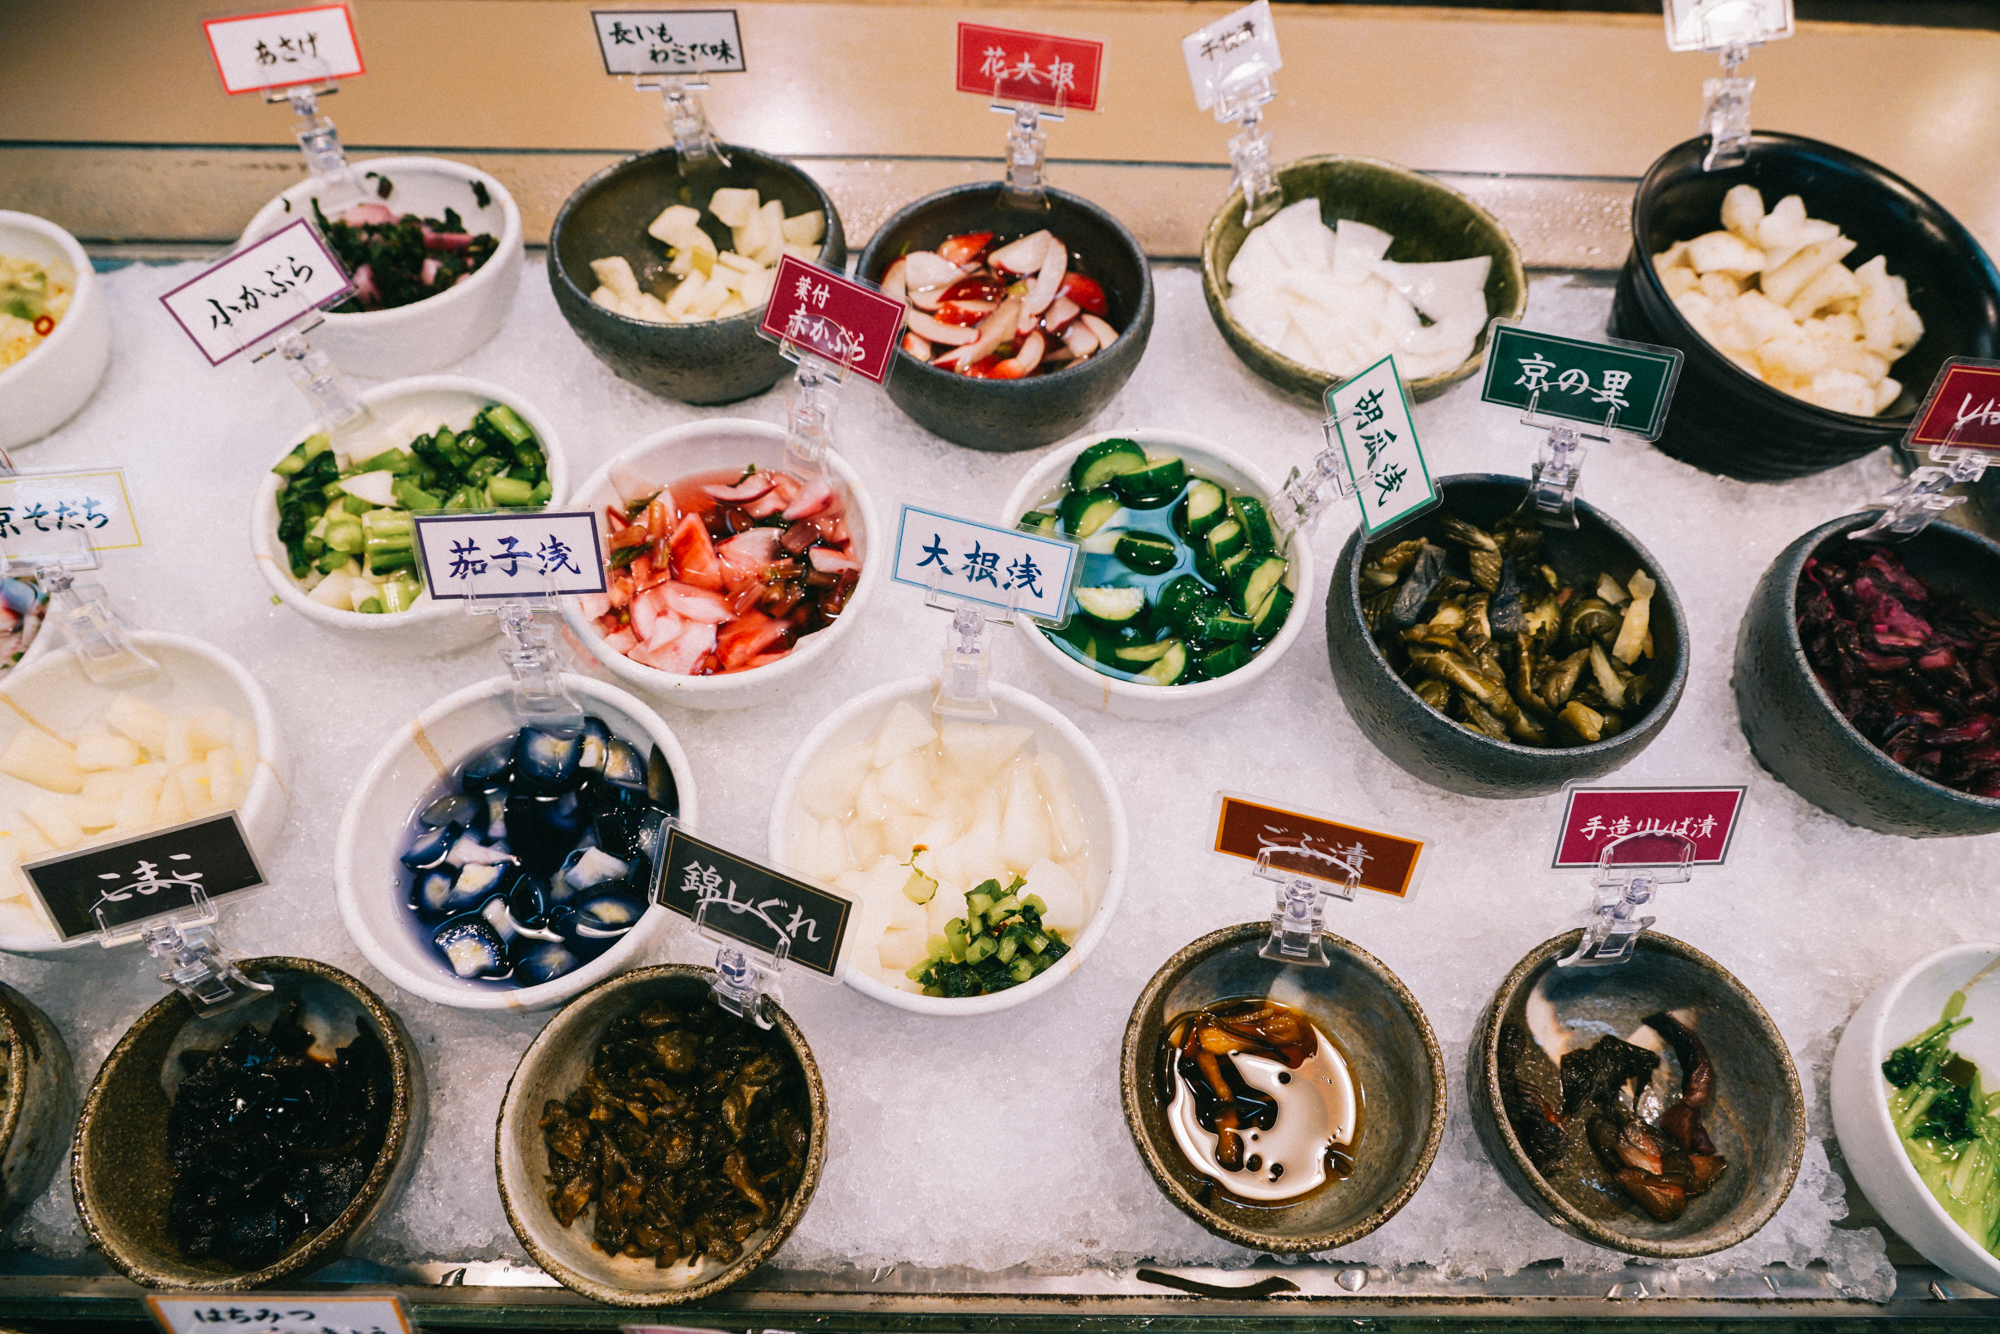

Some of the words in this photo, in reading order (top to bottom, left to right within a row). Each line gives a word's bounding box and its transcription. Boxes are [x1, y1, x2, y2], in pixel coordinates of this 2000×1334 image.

[255, 32, 318, 65] あさげ
[609, 21, 673, 45] 長いも
[981, 46, 1076, 90] 花大根
[205, 256, 311, 330] 小かぶら
[794, 275, 830, 309] 葉付
[785, 303, 866, 362] 赤かぶら
[1512, 353, 1631, 408] 京の里
[1353, 388, 1408, 508] 胡瓜浅
[448, 534, 580, 581] 茄子浅
[915, 533, 1042, 599] 大根浅
[1579, 814, 1718, 841] 手造りしば漬
[96, 853, 202, 901] こまこ
[680, 860, 822, 943] 錦しぐれ
[194, 1307, 316, 1324] はちみつ
